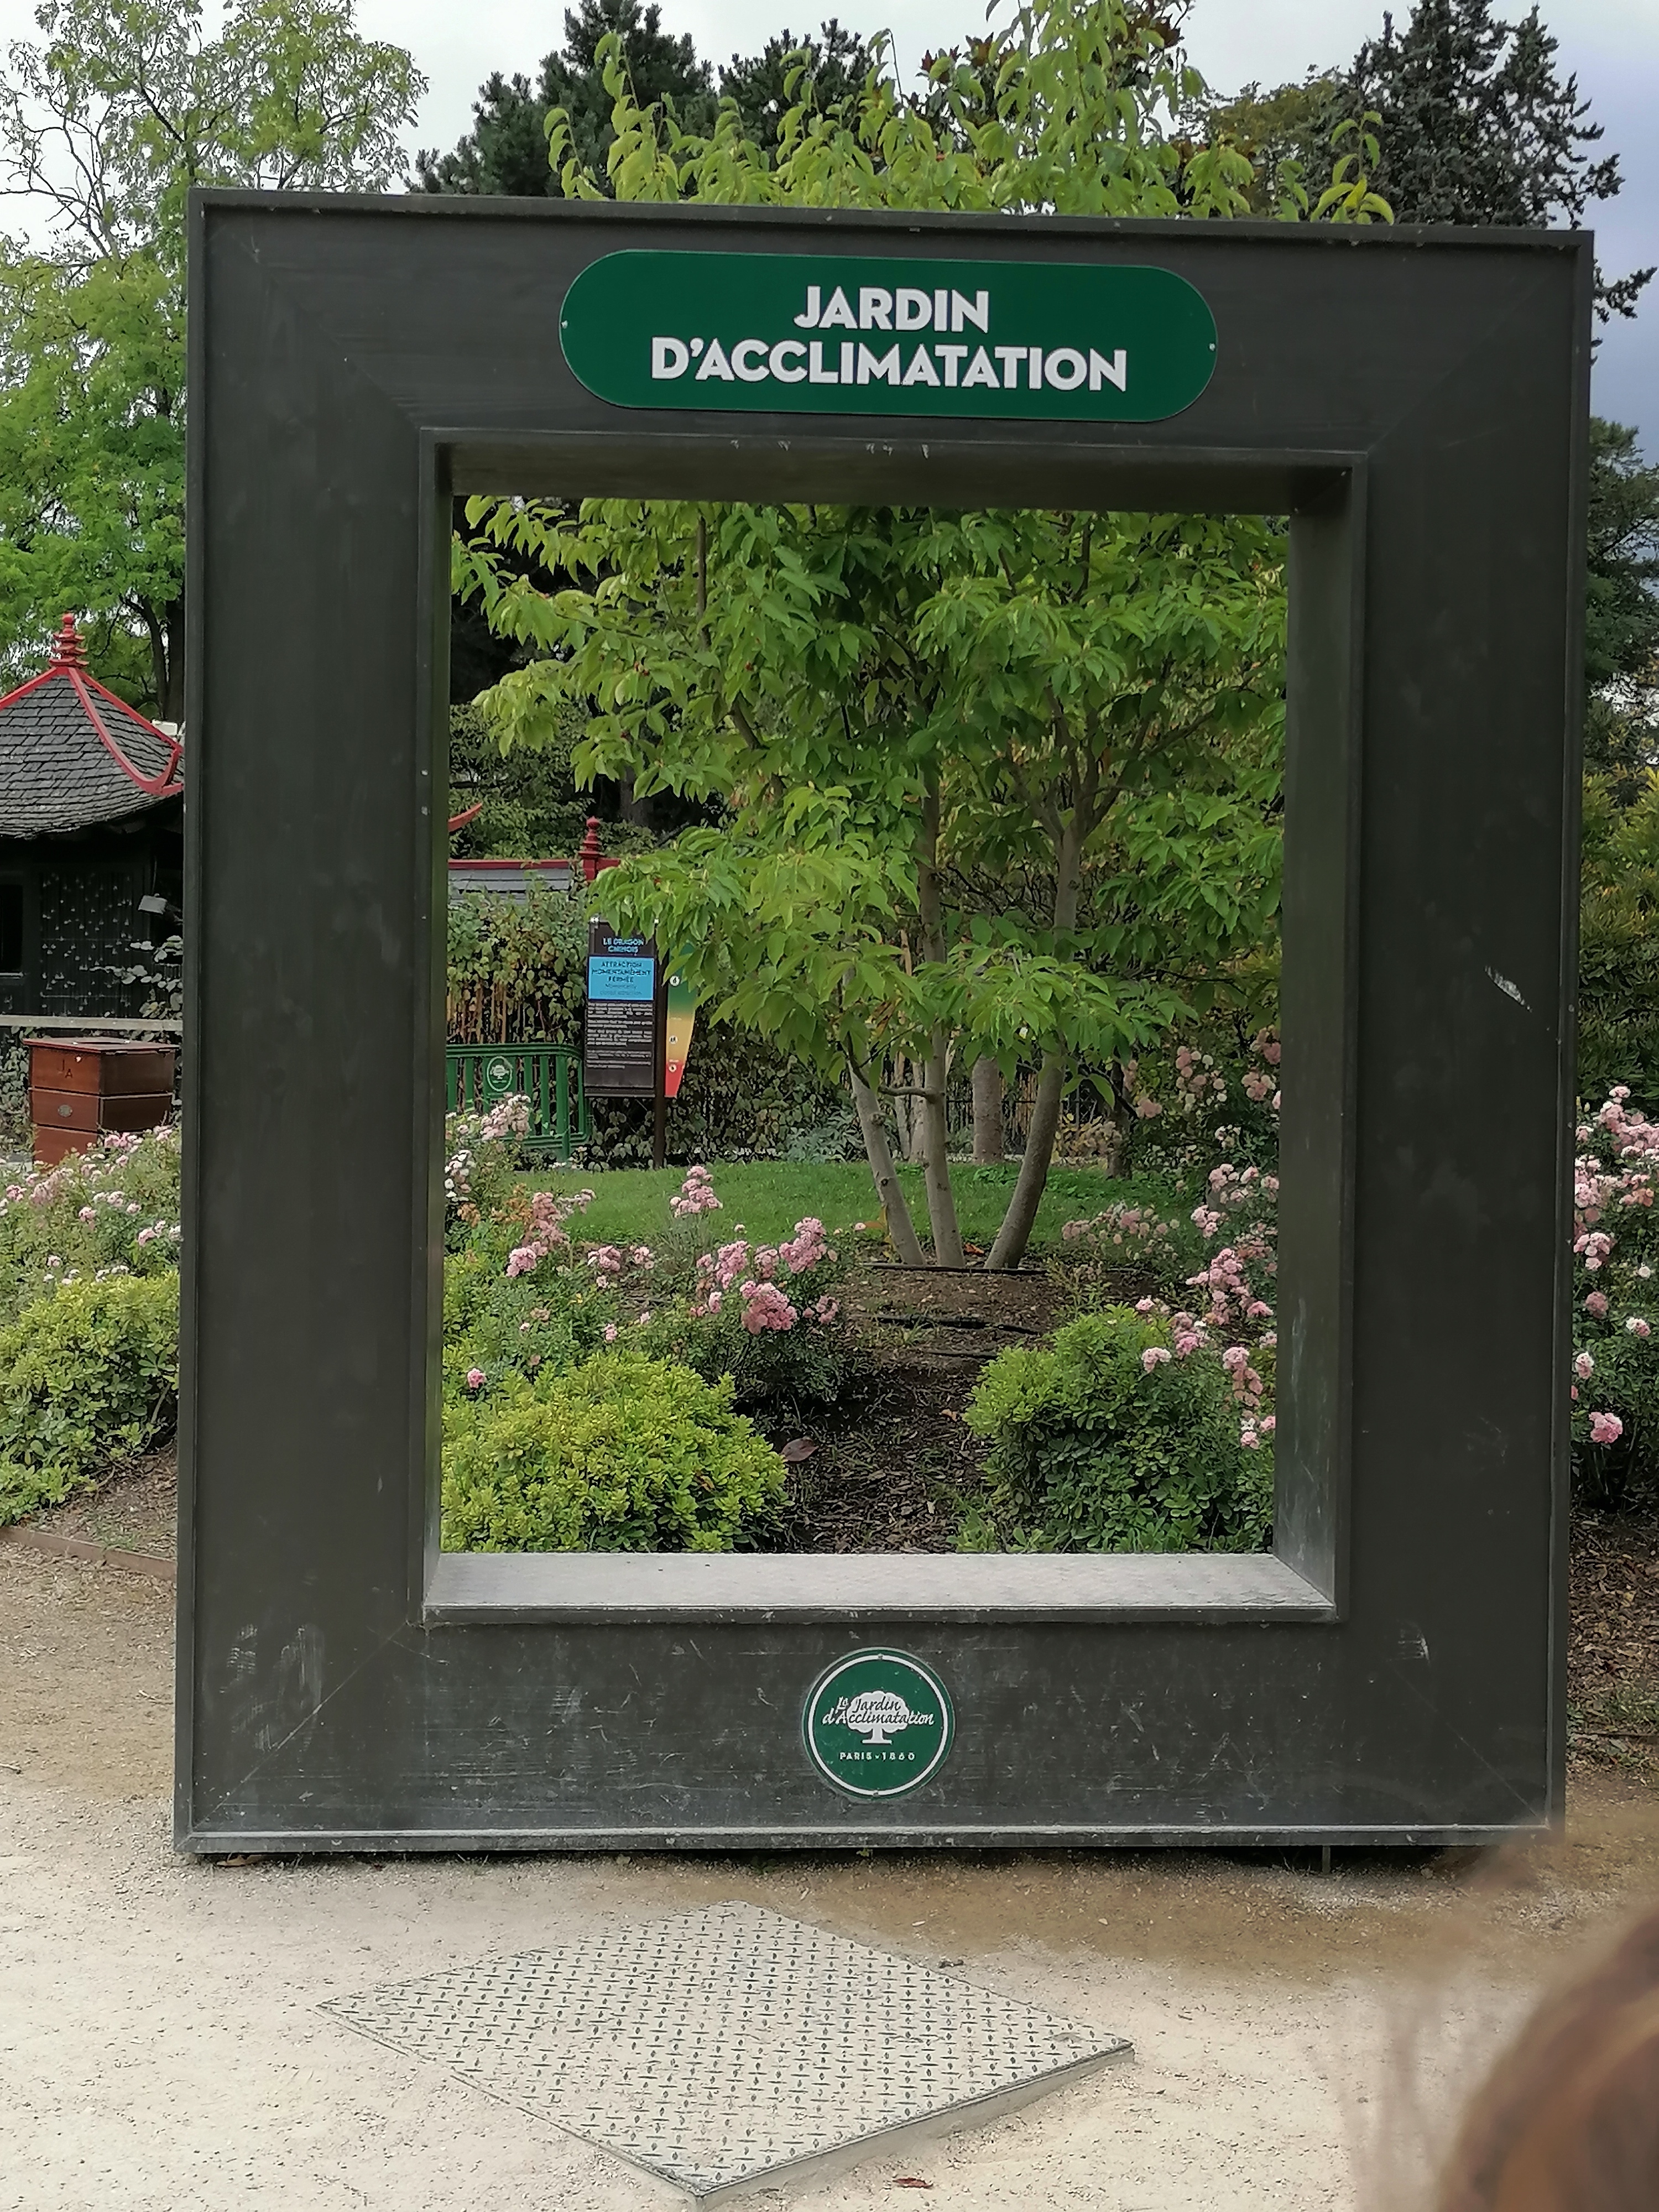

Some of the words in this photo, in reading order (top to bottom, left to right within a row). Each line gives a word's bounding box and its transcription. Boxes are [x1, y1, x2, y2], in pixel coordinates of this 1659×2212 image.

[794, 285, 989, 333] JARDIN
[652, 337, 1126, 392] D'ACCLIMATATION
[822, 1708, 935, 1725] d'Acclimatation
[852, 1695, 901, 1713] Jardin
